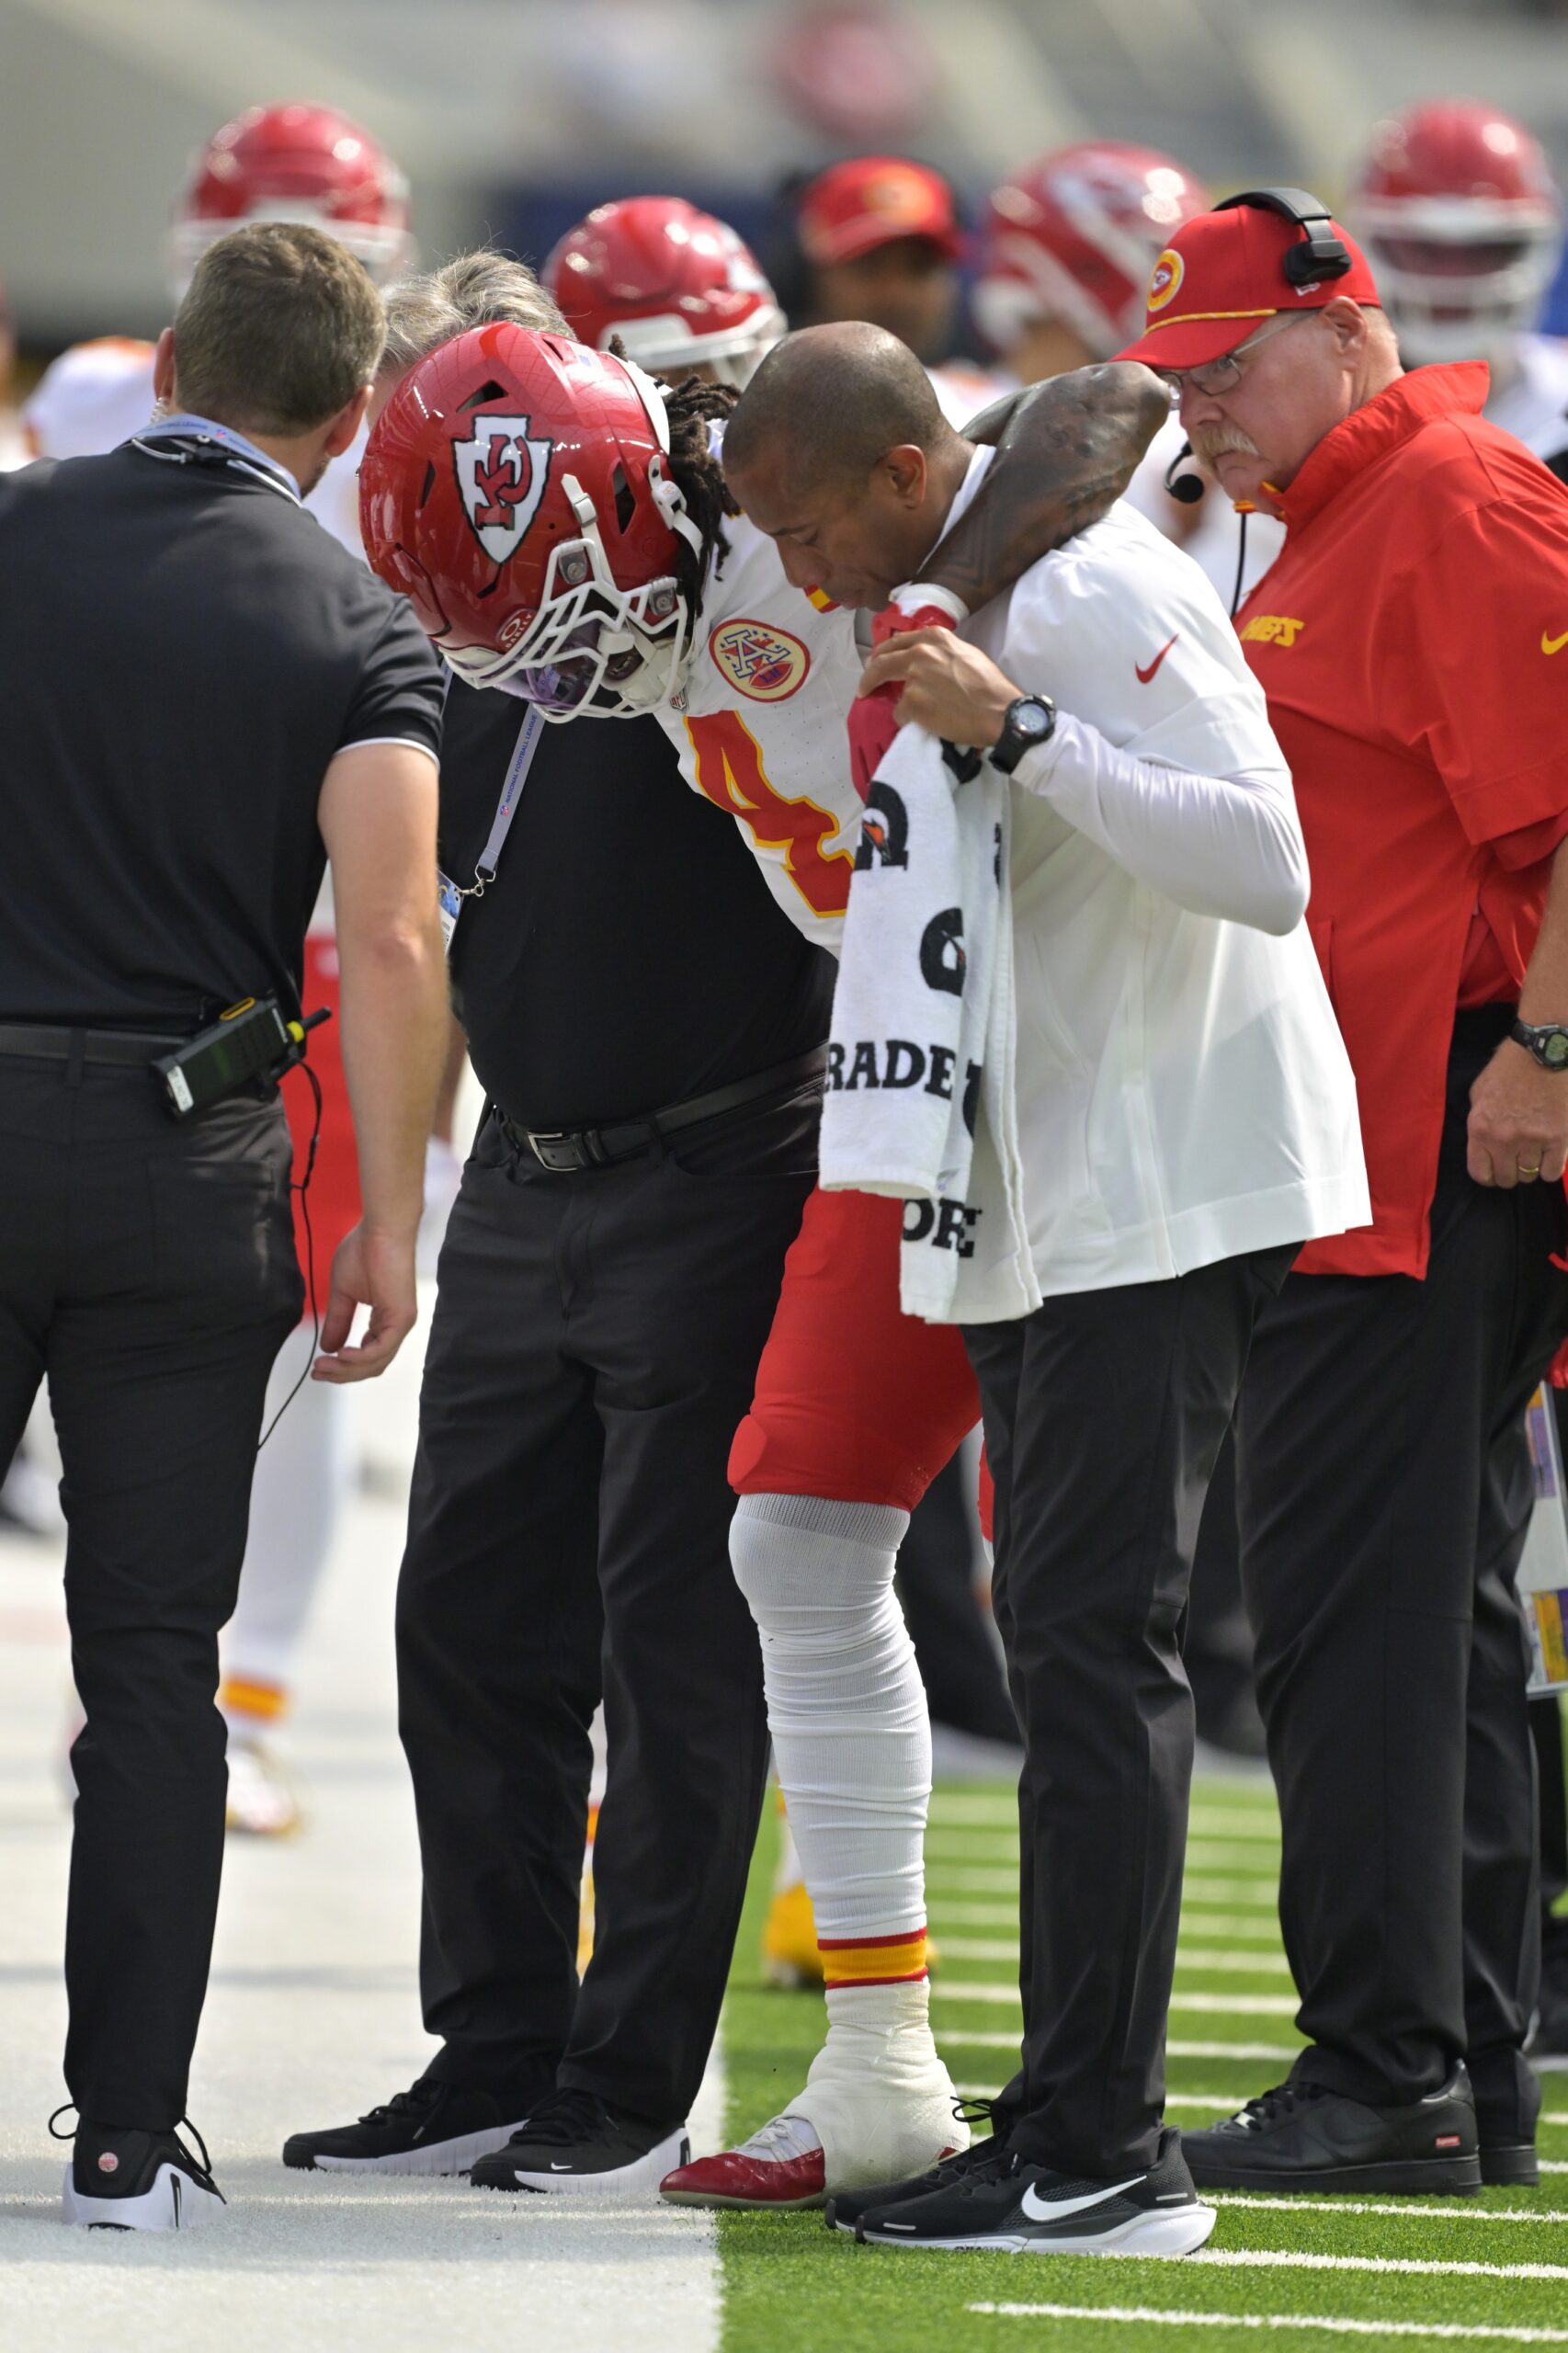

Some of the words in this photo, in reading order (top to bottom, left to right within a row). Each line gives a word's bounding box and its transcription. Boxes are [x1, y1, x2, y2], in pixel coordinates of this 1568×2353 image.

[506, 614, 532, 647] OAKLEY
[506, 773, 519, 804] NATIONAL
[514, 740, 529, 773] FOOTBALL
[525, 712, 538, 740] LEAGUE
[683, 710, 856, 919] 4
